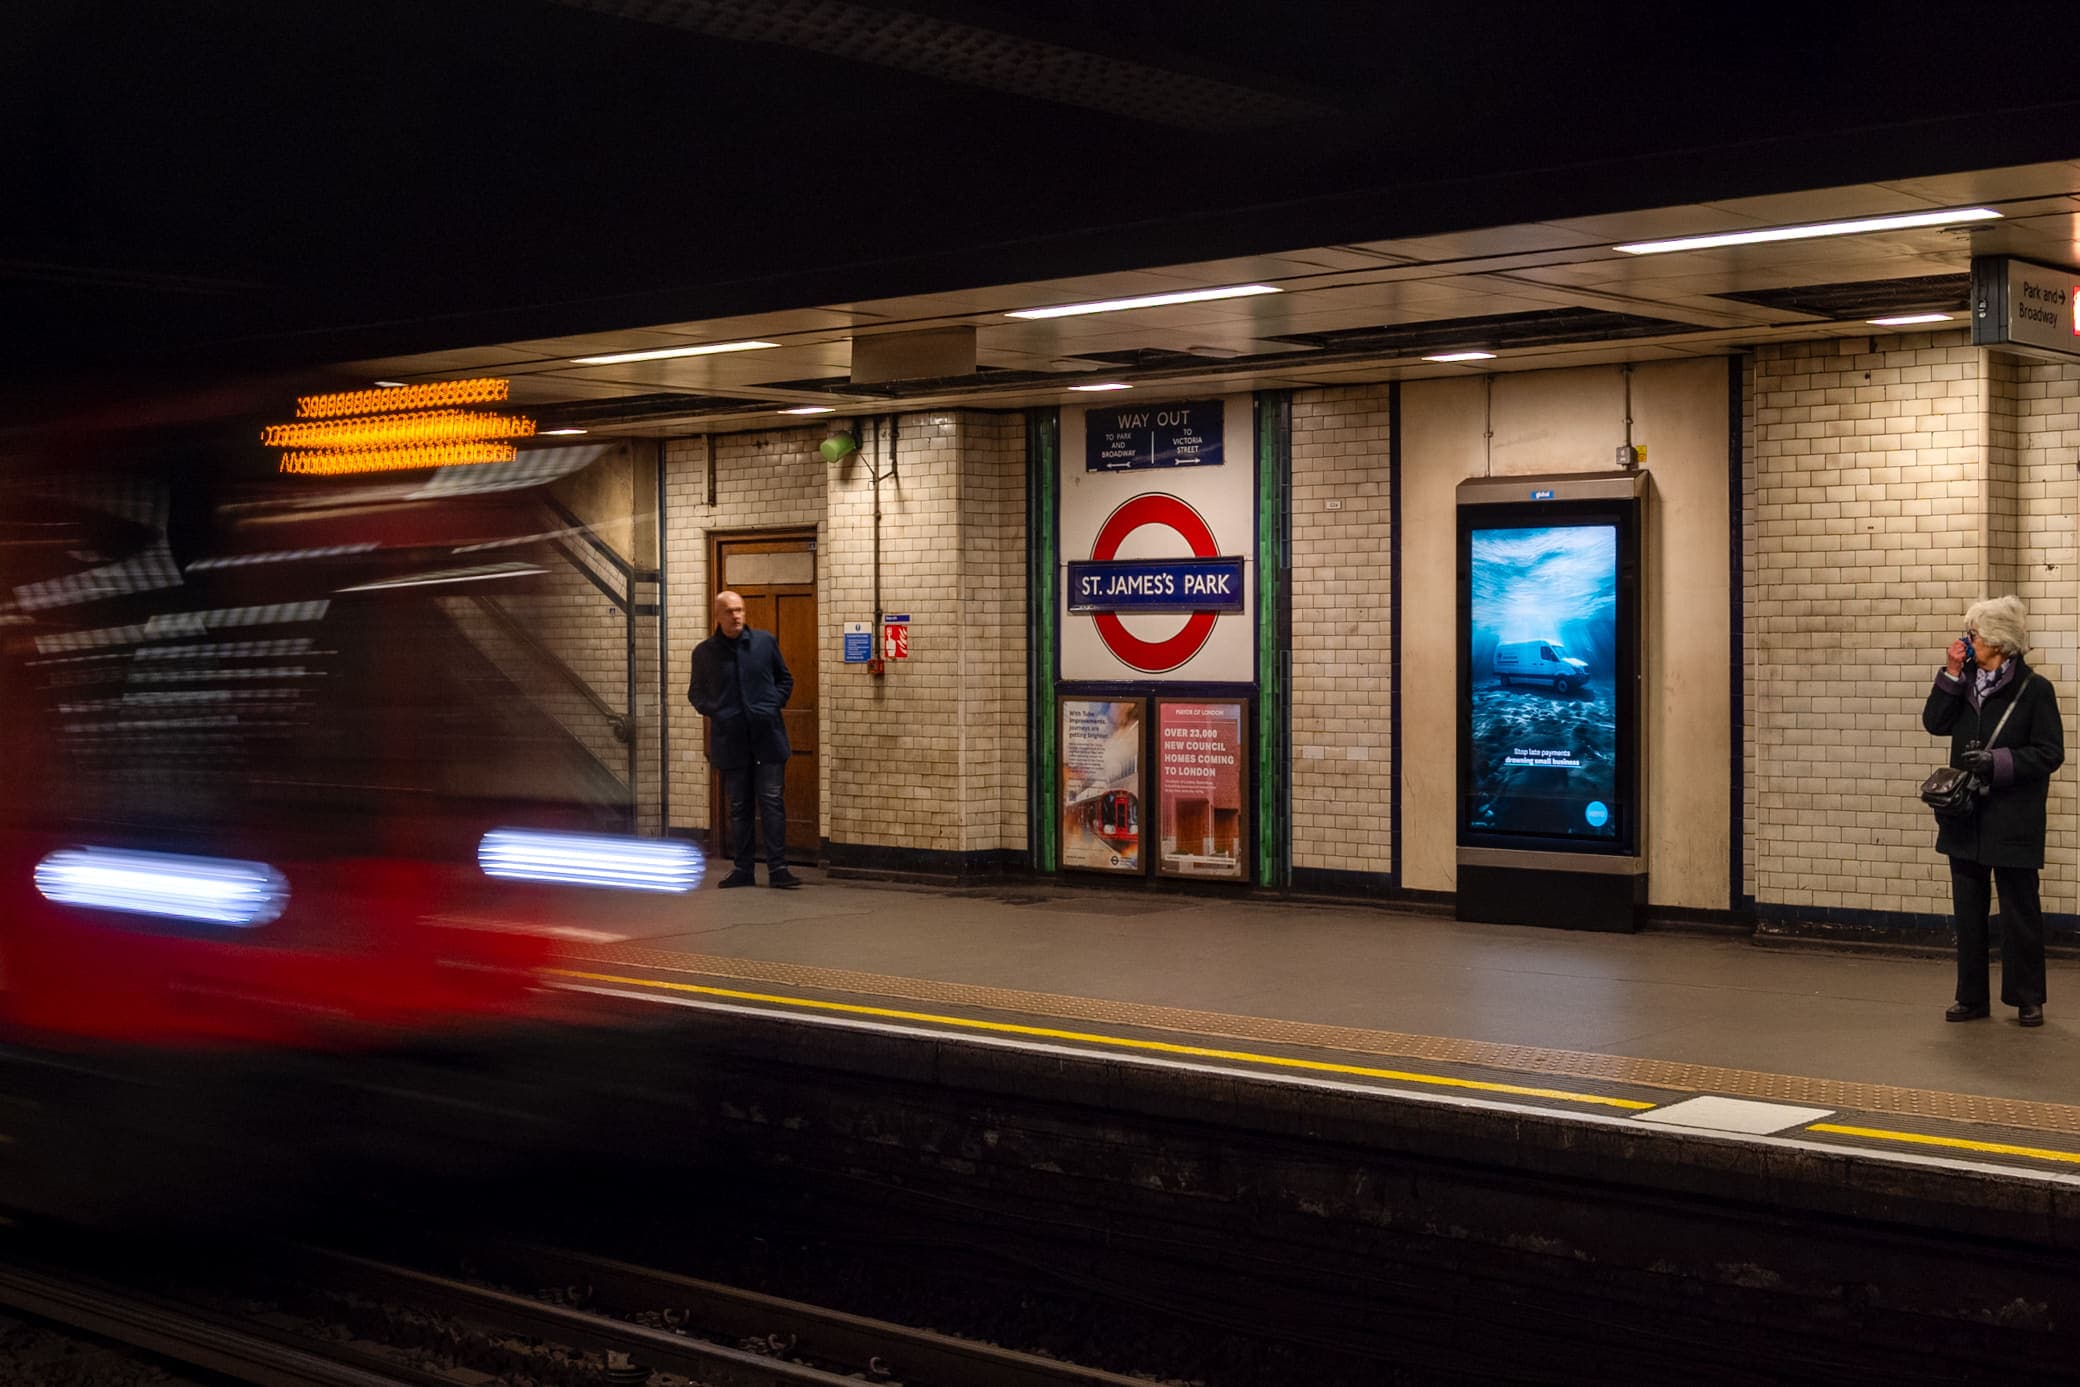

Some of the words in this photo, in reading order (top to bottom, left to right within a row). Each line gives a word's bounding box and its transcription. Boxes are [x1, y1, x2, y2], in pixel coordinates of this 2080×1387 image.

[2024, 281, 2041, 298] Park
[2043, 288, 2058, 304] and
[2019, 302, 2058, 328] Broadway
[1118, 413, 1150, 429] WAY
[1157, 410, 1190, 426] OUT
[1105, 433, 1114, 441] TO
[1117, 432, 1132, 440] PARK
[1183, 428, 1193, 436] TO
[1172, 436, 1203, 445] VICTORIA
[1101, 450, 1136, 458] BROADWAY
[1177, 445, 1199, 454] STREET
[1081, 575, 1103, 596] ST.
[1106, 572, 1175, 596] JAMES'S
[1184, 574, 1231, 595] PARK
[1164, 728, 1188, 737] OVER
[1190, 728, 1217, 738] 23,000
[1164, 741, 1184, 750] NEW
[1186, 742, 1226, 751] COUNCIL
[1513, 748, 1528, 756] Stop
[1529, 748, 1540, 756] late
[1541, 749, 1571, 757] payments
[1164, 754, 1196, 763] HOMES
[1197, 754, 1235, 765] COMING
[1505, 756, 1534, 765] drowning
[1534, 757, 1551, 765] small
[1552, 757, 1580, 766] business
[1164, 767, 1177, 775] TO
[1178, 767, 1216, 777] LONDON
